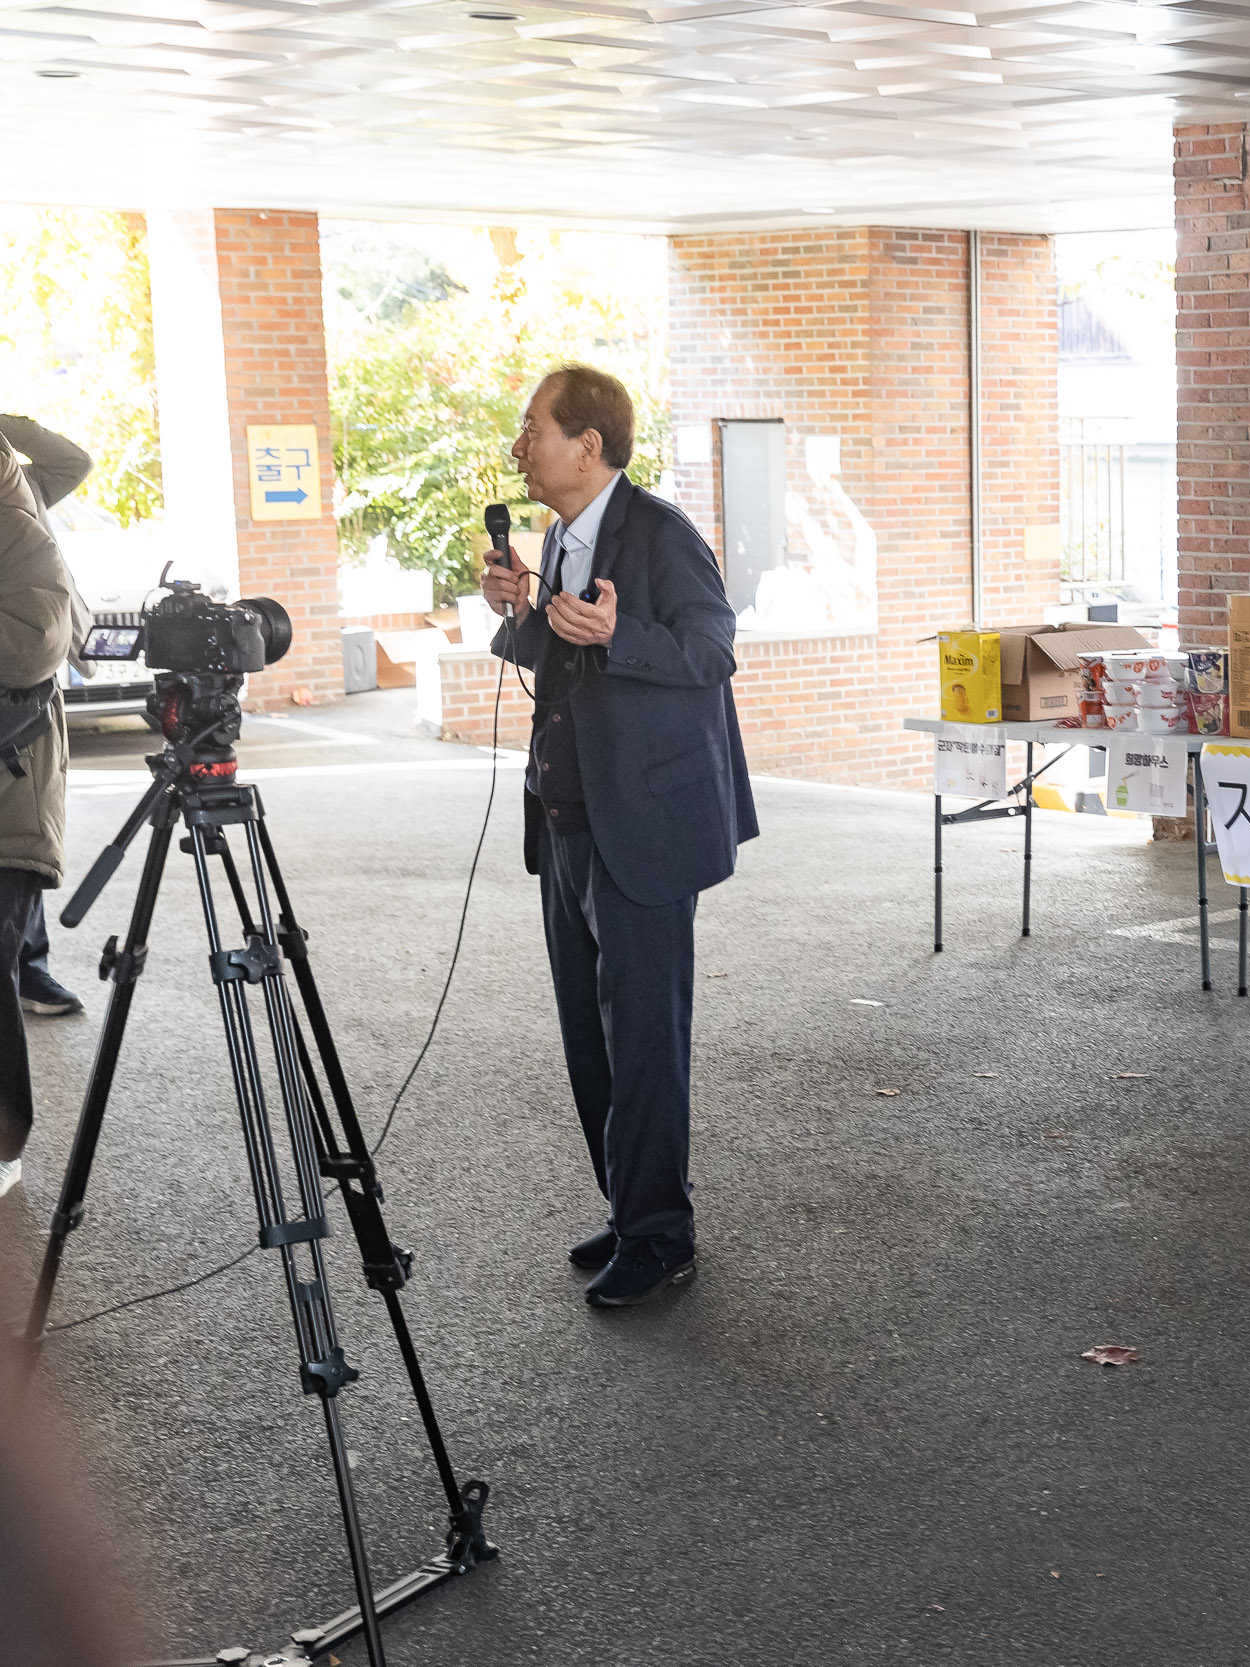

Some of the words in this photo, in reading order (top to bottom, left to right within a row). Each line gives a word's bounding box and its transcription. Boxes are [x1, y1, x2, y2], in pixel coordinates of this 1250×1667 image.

[256, 447, 312, 482] 출구
[944, 653, 975, 667] Maxim
[1125, 752, 1169, 769] 희망하우스
